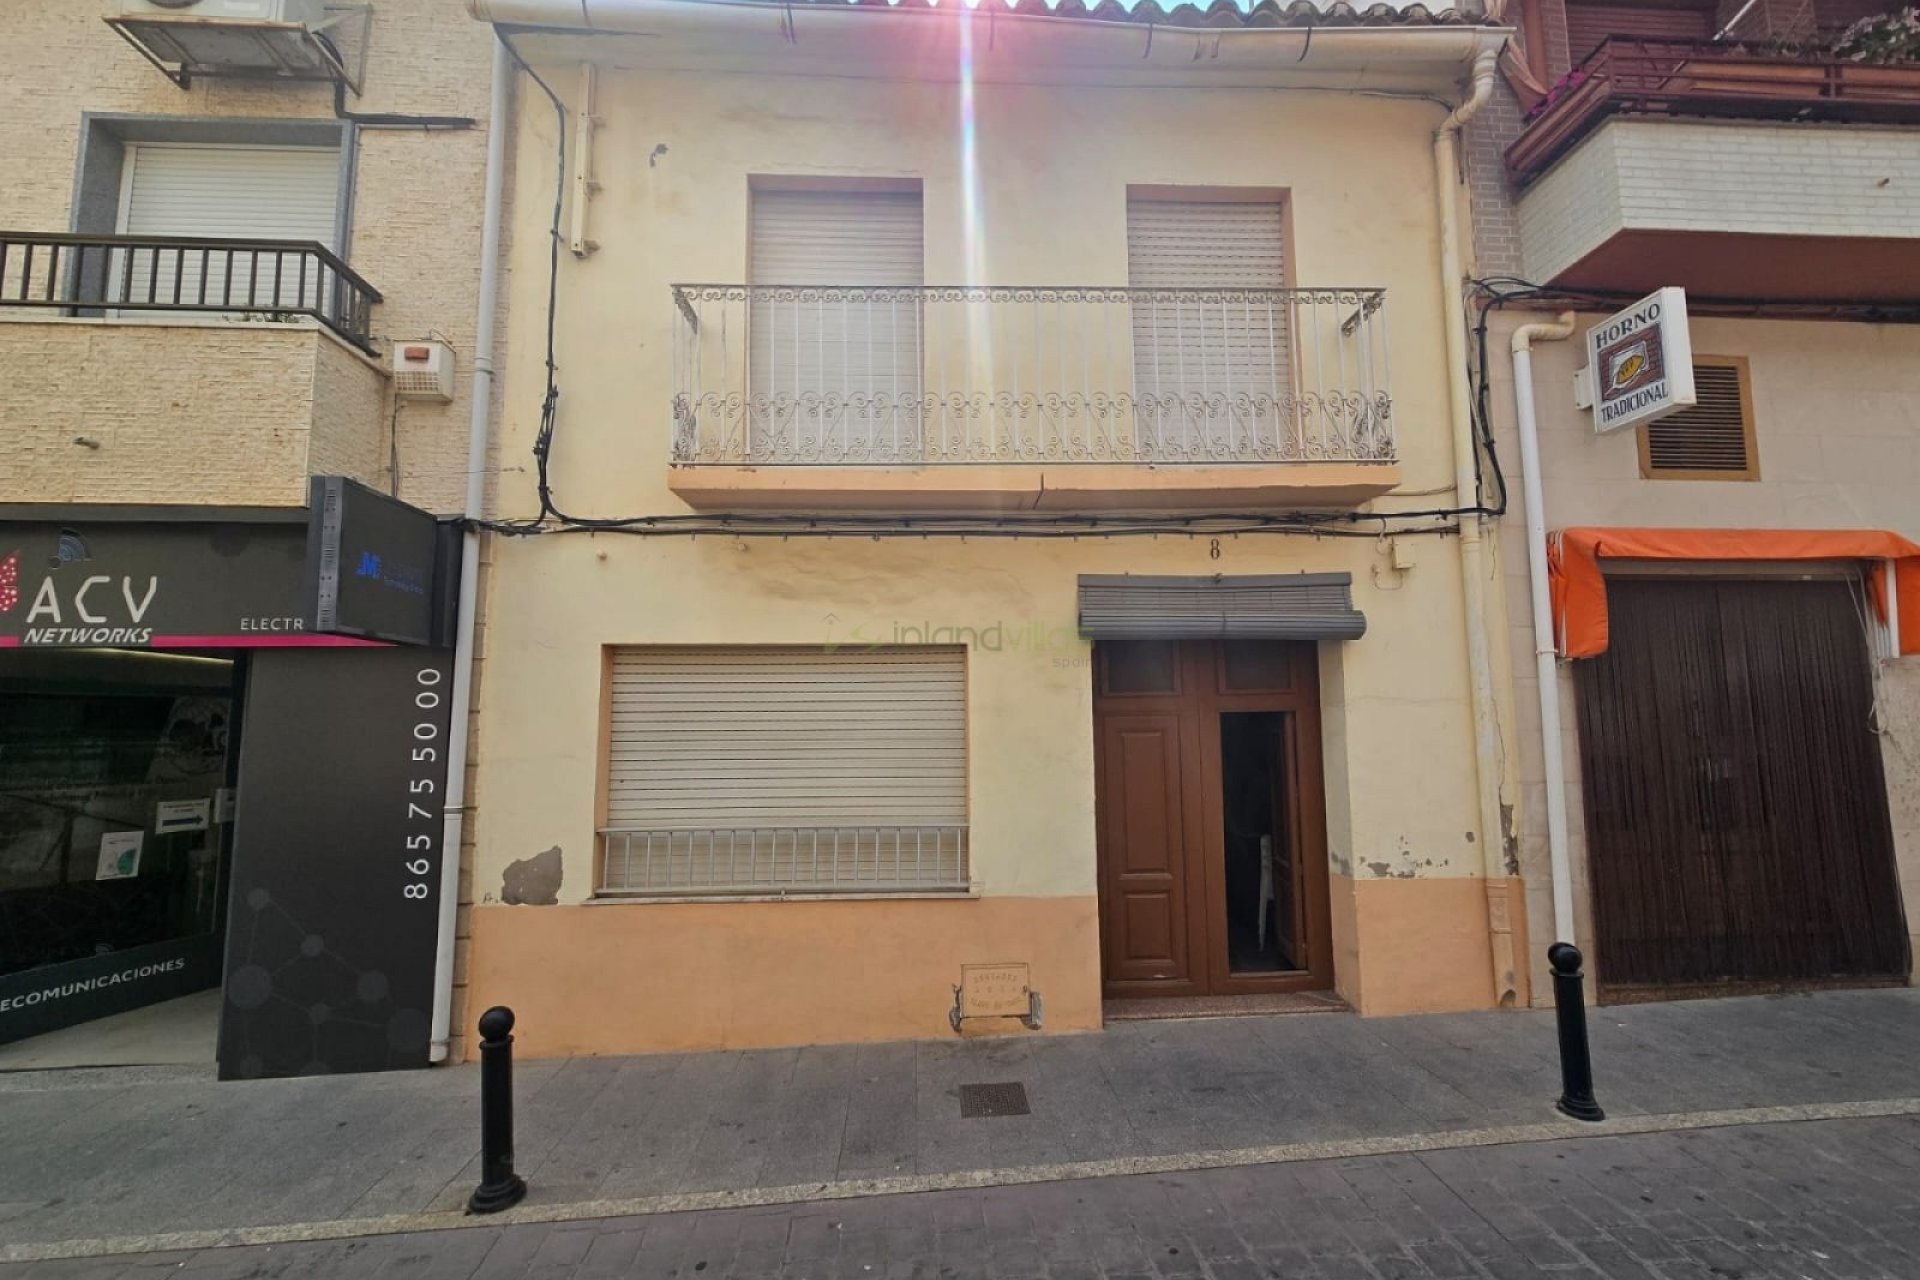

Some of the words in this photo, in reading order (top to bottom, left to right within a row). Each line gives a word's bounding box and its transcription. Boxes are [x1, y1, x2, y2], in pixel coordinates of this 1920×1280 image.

[1596, 303, 1660, 348] HORNO
[1601, 382, 1668, 423] TRADICIONAL
[1210, 539, 1220, 560] 8
[26, 576, 157, 623] ACV
[24, 627, 152, 645] NETWORKS
[240, 617, 304, 631] ELECTR
